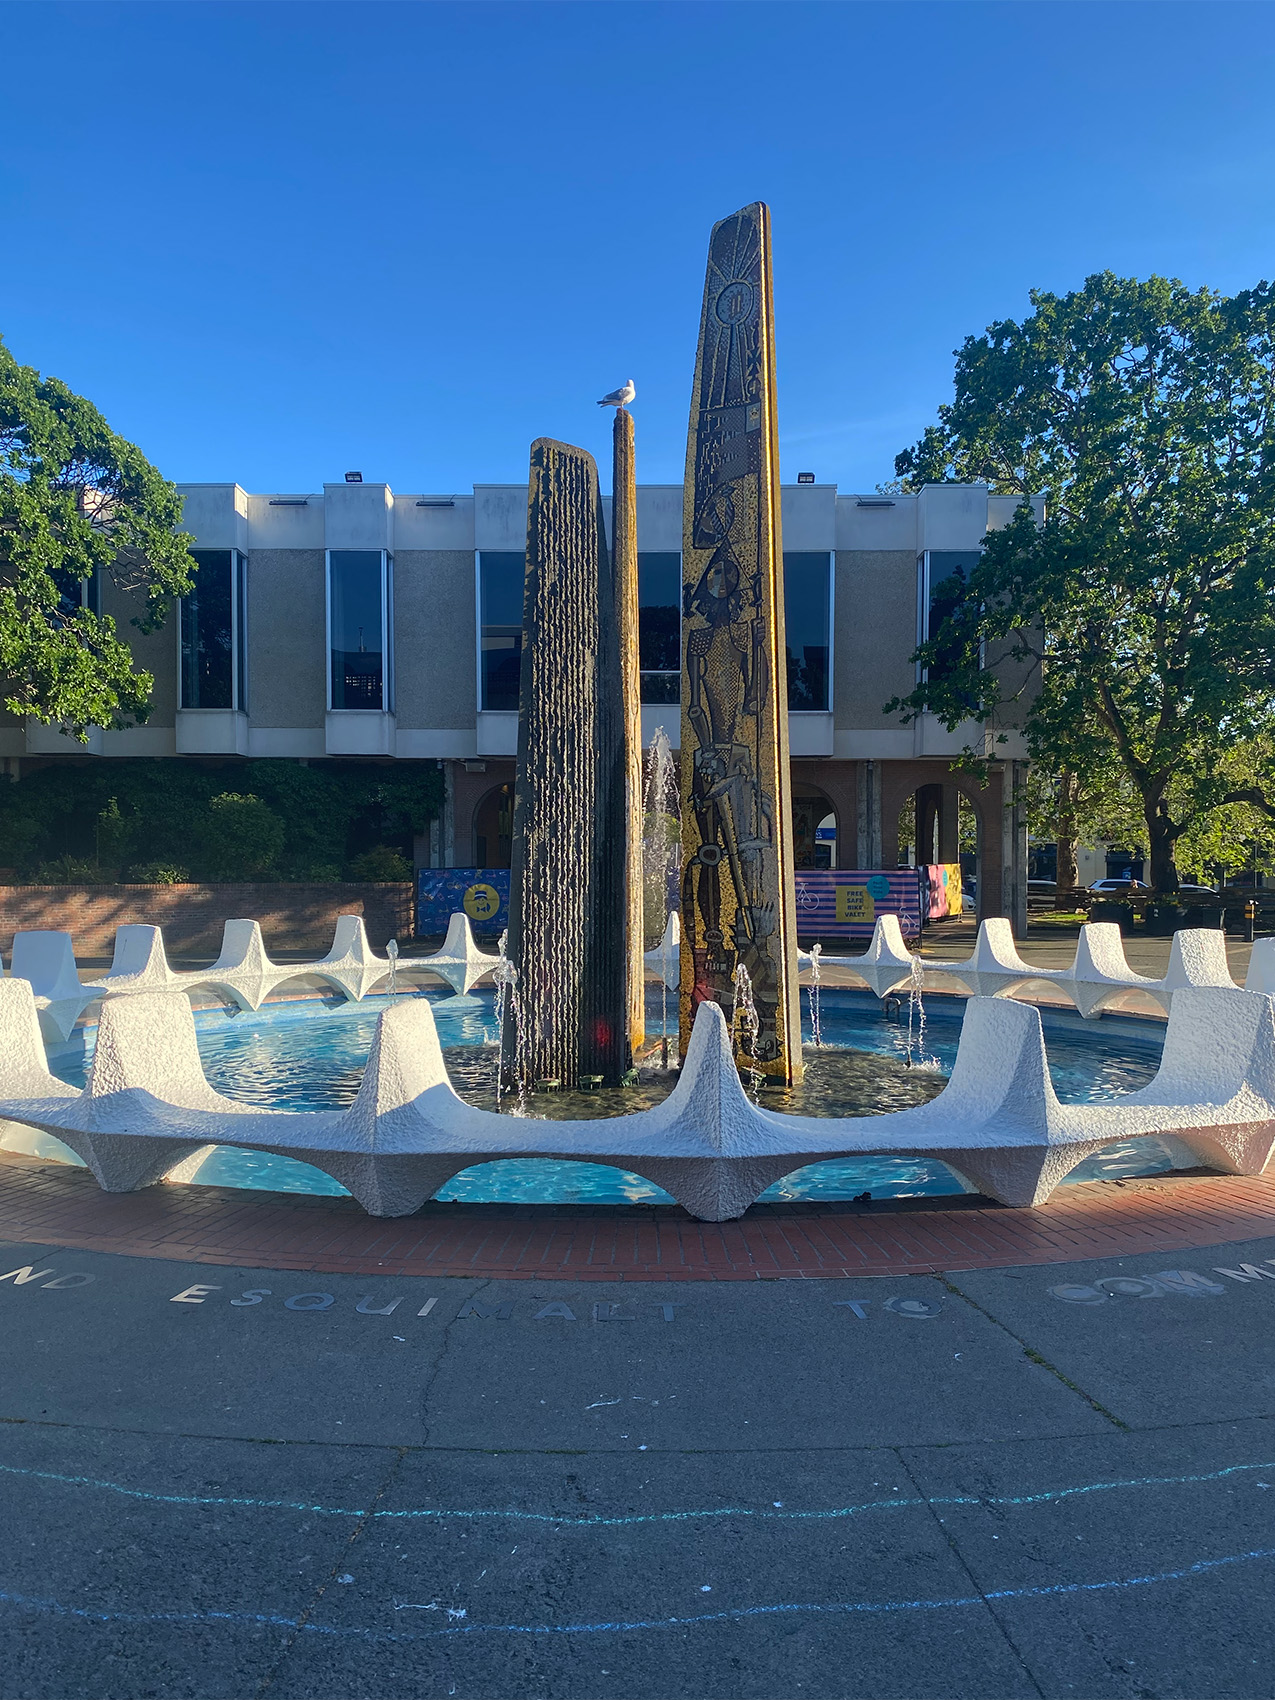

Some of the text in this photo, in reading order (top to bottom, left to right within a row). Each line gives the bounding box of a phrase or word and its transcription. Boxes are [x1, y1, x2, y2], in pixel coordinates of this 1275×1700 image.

[170, 1283, 687, 1323] ESQUIMALT
[832, 1299, 943, 1319] TO
[1052, 1259, 1275, 1302] COMM
